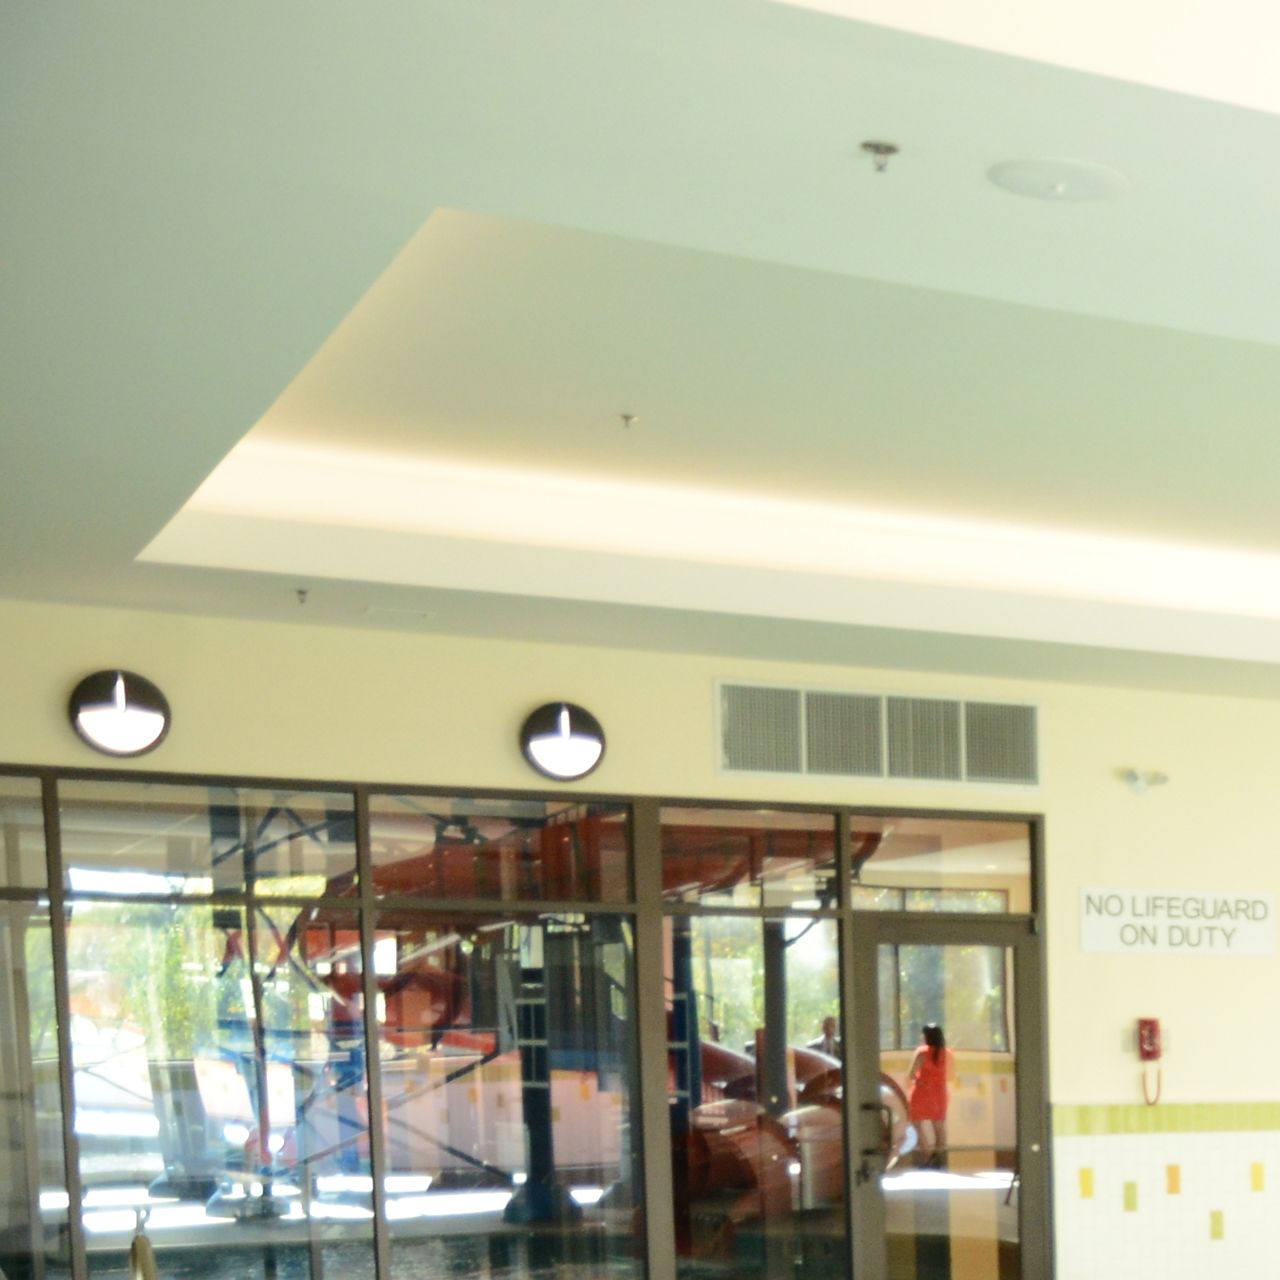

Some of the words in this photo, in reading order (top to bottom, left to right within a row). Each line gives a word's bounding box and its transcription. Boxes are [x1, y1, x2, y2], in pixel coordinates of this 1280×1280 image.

[1085, 893, 1124, 916] NO
[1131, 896, 1269, 921] LIFEGUARD
[1119, 923, 1157, 946] ON
[1167, 925, 1237, 948] DUTY
